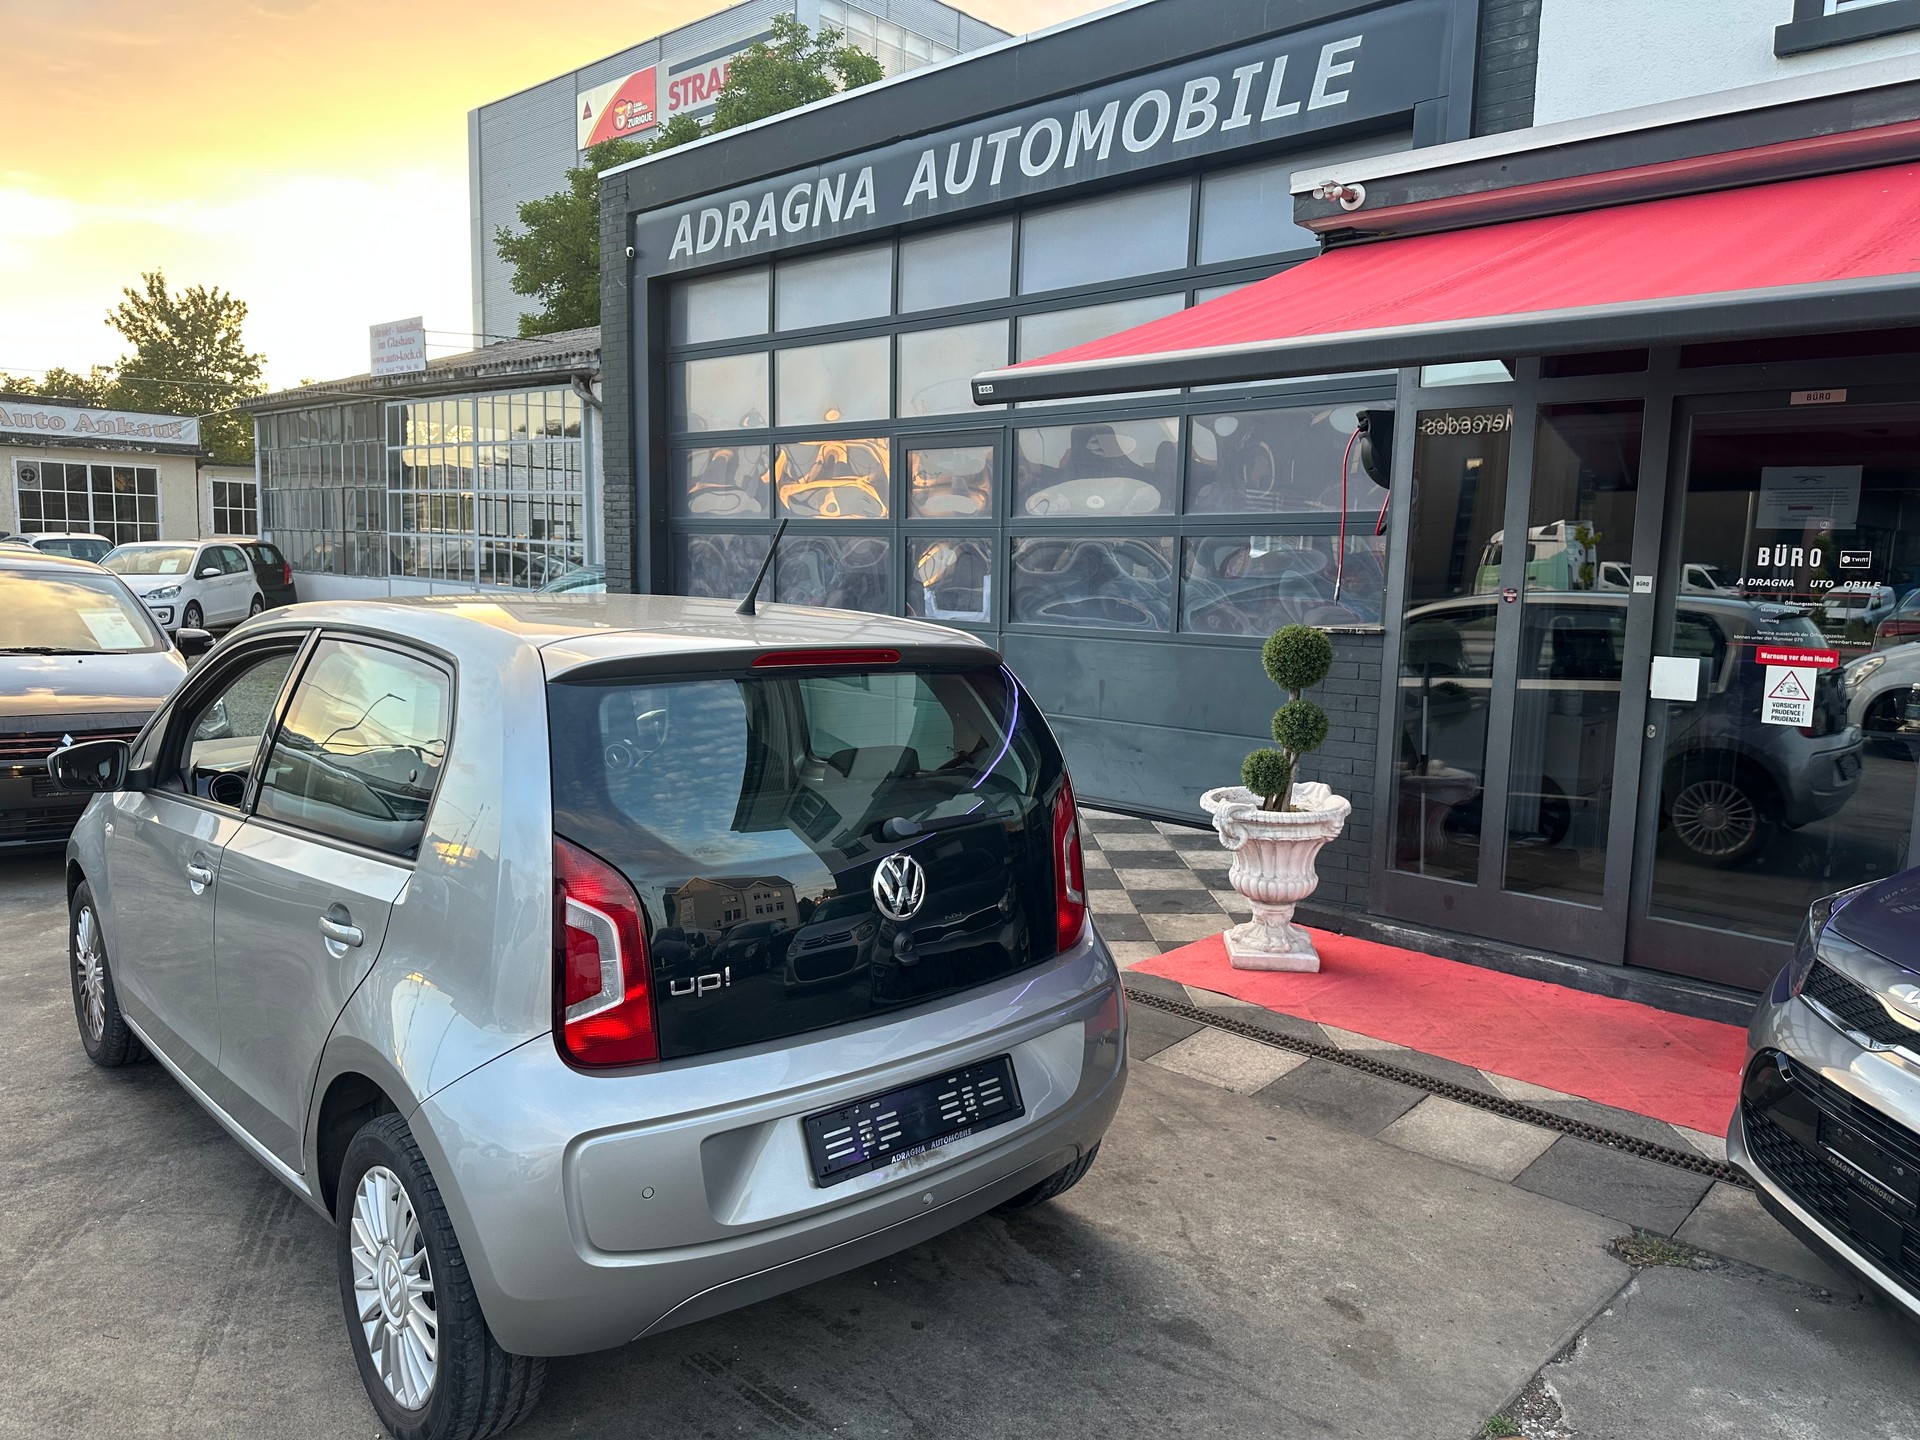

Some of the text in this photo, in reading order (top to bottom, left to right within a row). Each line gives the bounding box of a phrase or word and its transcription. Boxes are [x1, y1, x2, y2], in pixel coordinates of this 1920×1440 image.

[627, 113, 653, 128] ZURIQUE
[668, 35, 1363, 261] ADRAGNA AUTOMOBILE
[387, 336, 416, 348] Glashaus
[1806, 391, 1831, 401] BÜRO
[73, 413, 183, 439] Ankauf
[1757, 544, 1822, 568] BÜRO
[1809, 579, 1835, 588] UTO
[1843, 581, 1882, 590] OBILE
[1761, 652, 1788, 661] Warnung
[1770, 715, 1800, 723] PRUDENZA
[670, 966, 731, 998] up!
[891, 1127, 972, 1164] ADRAGNA AUTOMOBILE
[1827, 1155, 1896, 1205] ADRAGNA AUTOMOBILE
